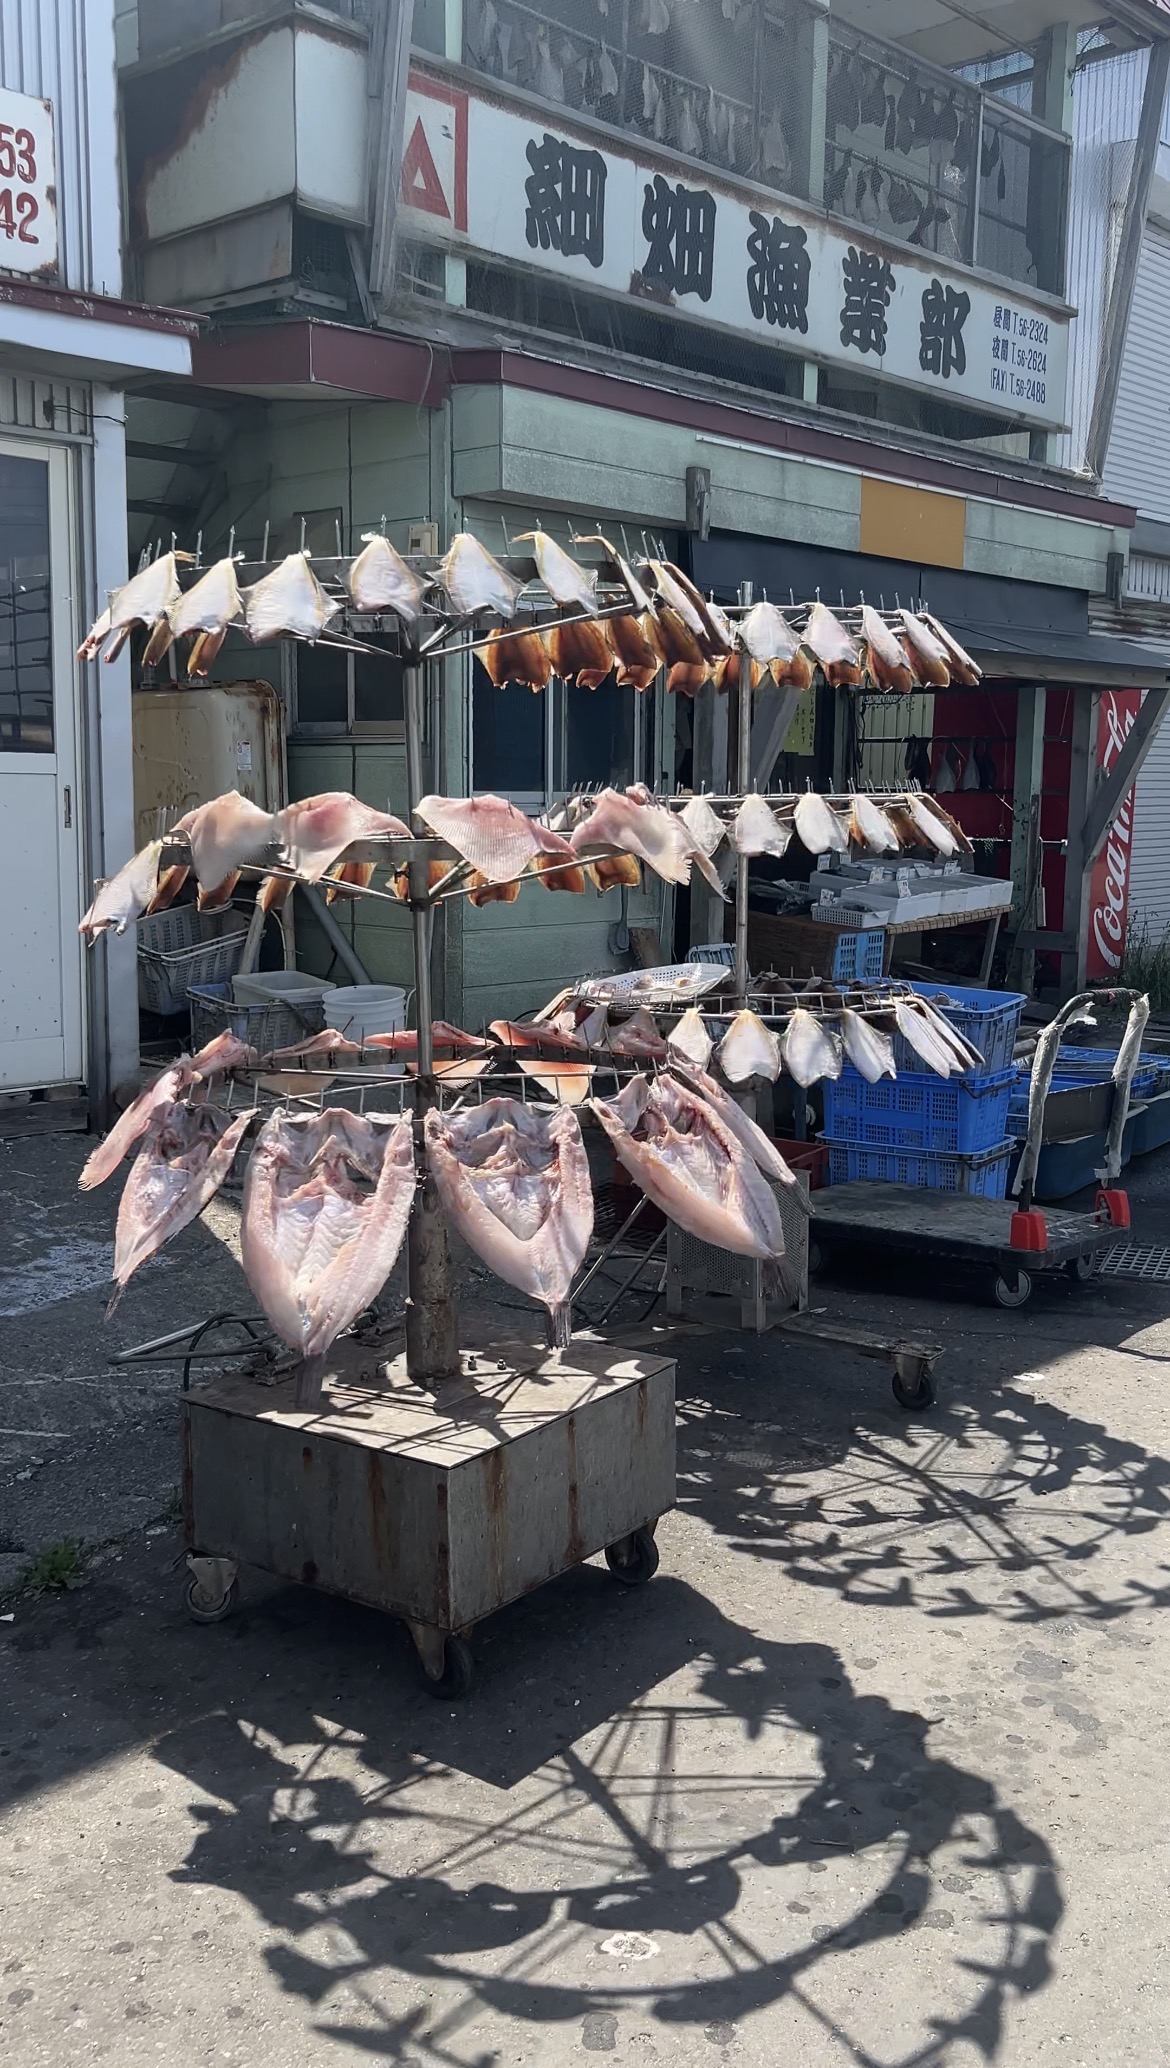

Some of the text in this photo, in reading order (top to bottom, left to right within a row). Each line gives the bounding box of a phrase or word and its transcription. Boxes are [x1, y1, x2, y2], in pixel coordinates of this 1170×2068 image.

[0, 123, 37, 184] 53
[524, 132, 971, 379] 細畑漁業部
[993, 305, 1011, 331] 昼間
[992, 335, 1009, 362] 夜間
